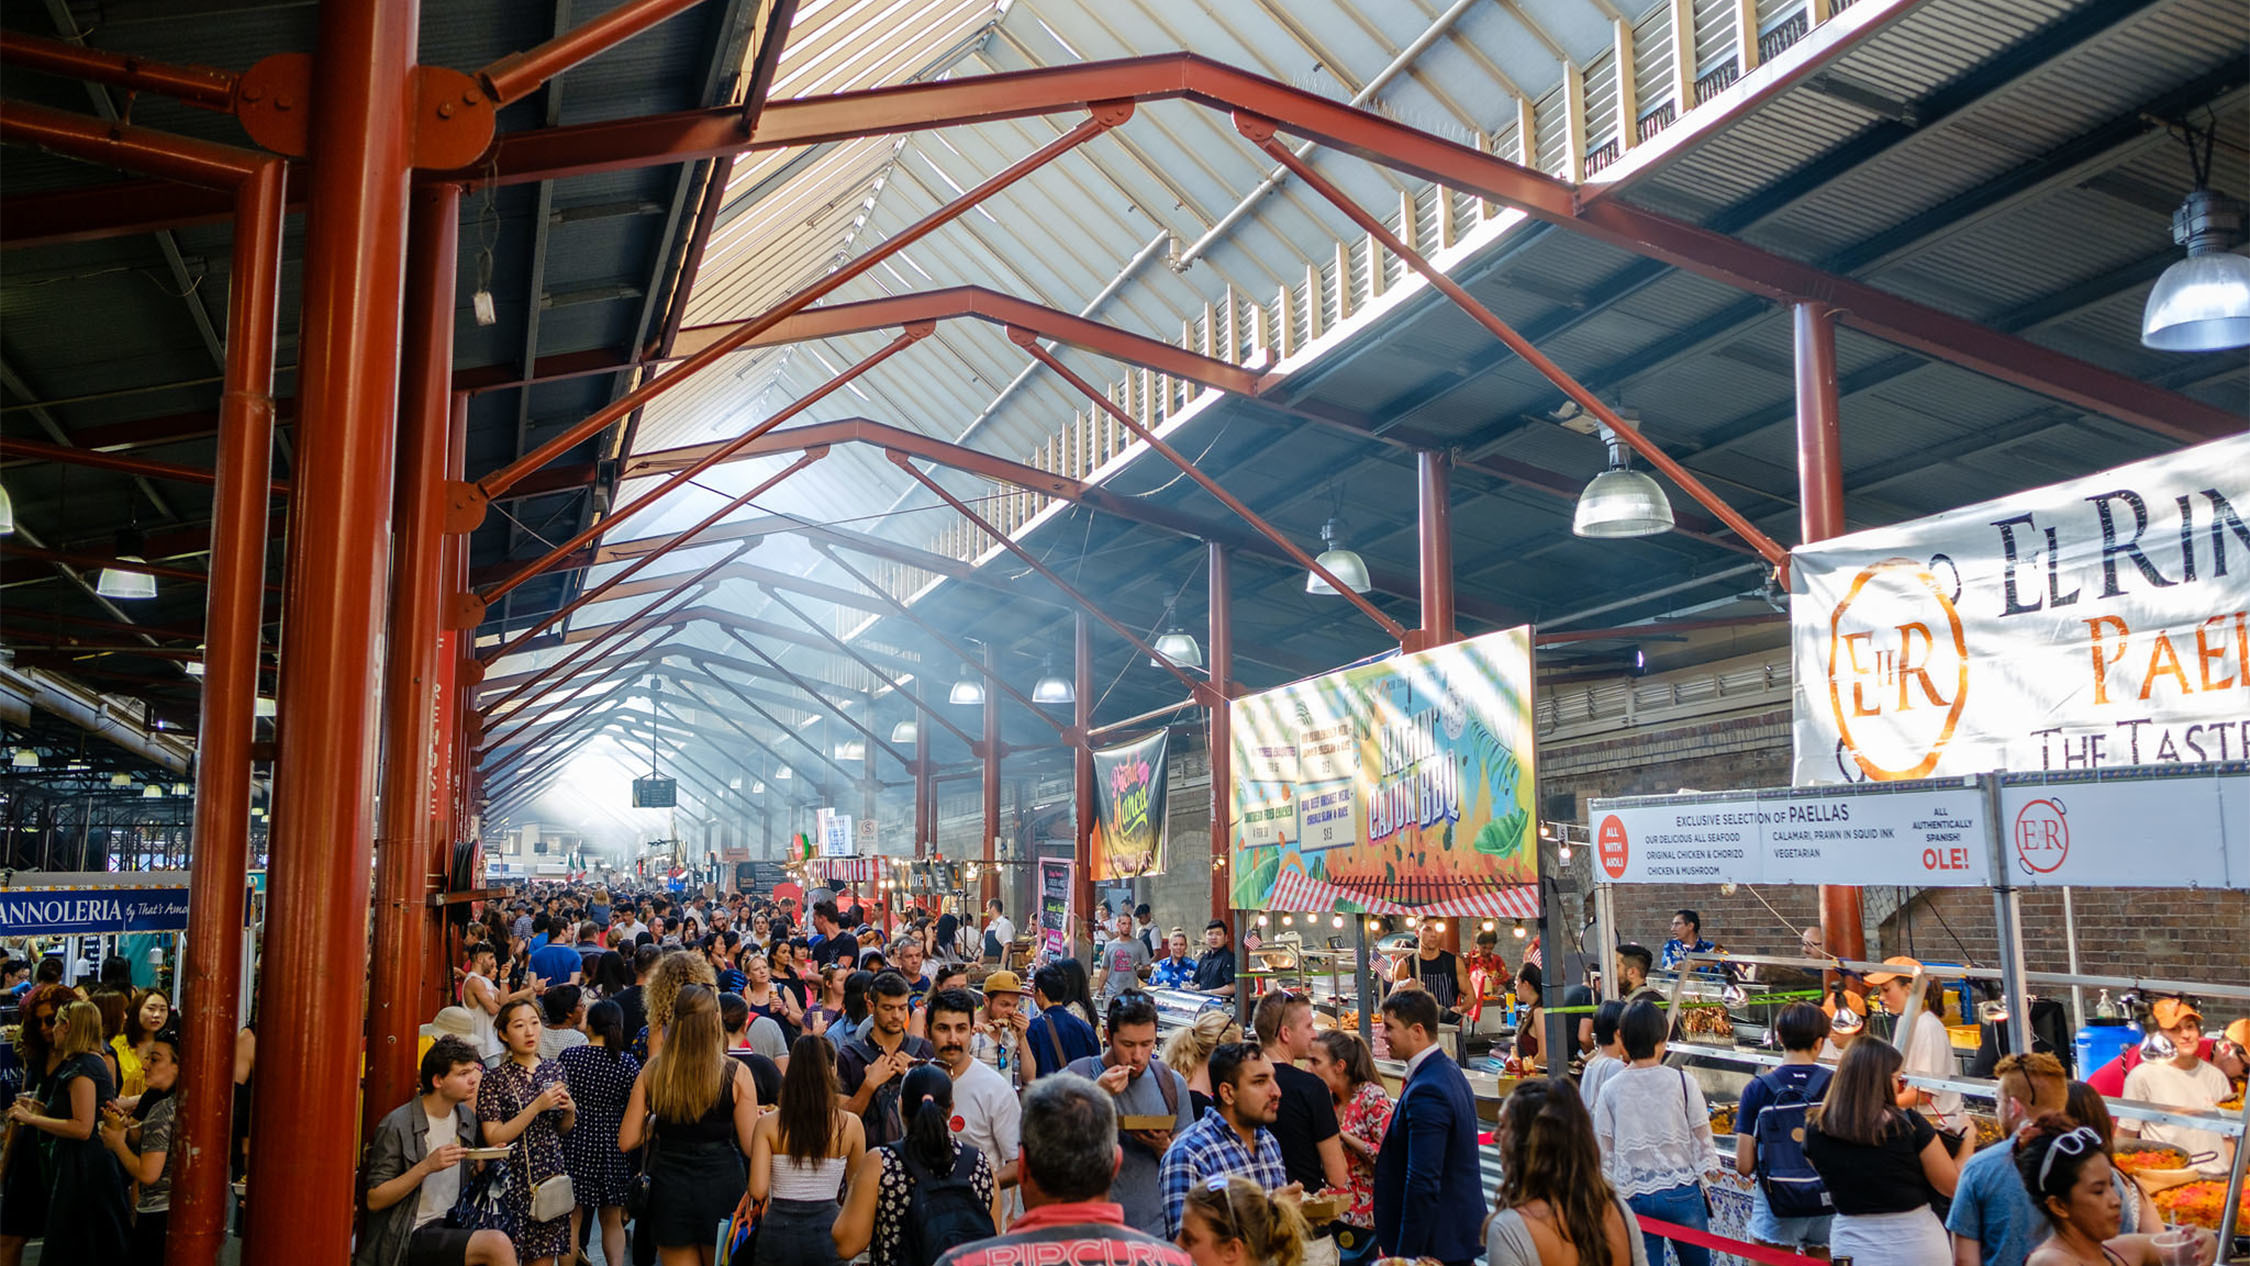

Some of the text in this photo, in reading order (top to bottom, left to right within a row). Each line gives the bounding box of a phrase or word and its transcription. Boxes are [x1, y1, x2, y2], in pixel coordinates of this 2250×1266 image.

[1368, 749, 1461, 841] CAJUN BBQ
[1676, 803, 1850, 828] EXCLUSIVE SELECTION OF PAELLAS
[1934, 807, 1949, 816] ALL
[1912, 819, 1973, 830] AUTHENTICALLY
[1606, 827, 1620, 838] ALL
[1645, 832, 1741, 845] OUR DELICIOUS ALL SEAFOOD
[1814, 829, 1842, 840] PRAWN
[1843, 829, 1852, 839] IN
[1853, 828, 1879, 841] SQUID
[1879, 828, 1895, 839] INK
[1926, 833, 1961, 843] SPANISH!
[1604, 841, 1623, 853] WITH
[1646, 850, 1676, 861] ORIGINAL
[1677, 849, 1706, 860] CHICKEN
[1712, 848, 1744, 859] CHORIZO
[1774, 848, 1821, 859] VEGETARIAN
[1922, 848, 1969, 870] OLE!
[1647, 866, 1675, 876] CHICKEN
[1681, 865, 1721, 876] MUSHROOM
[125, 902, 135, 923] by
[138, 902, 164, 916] That's
